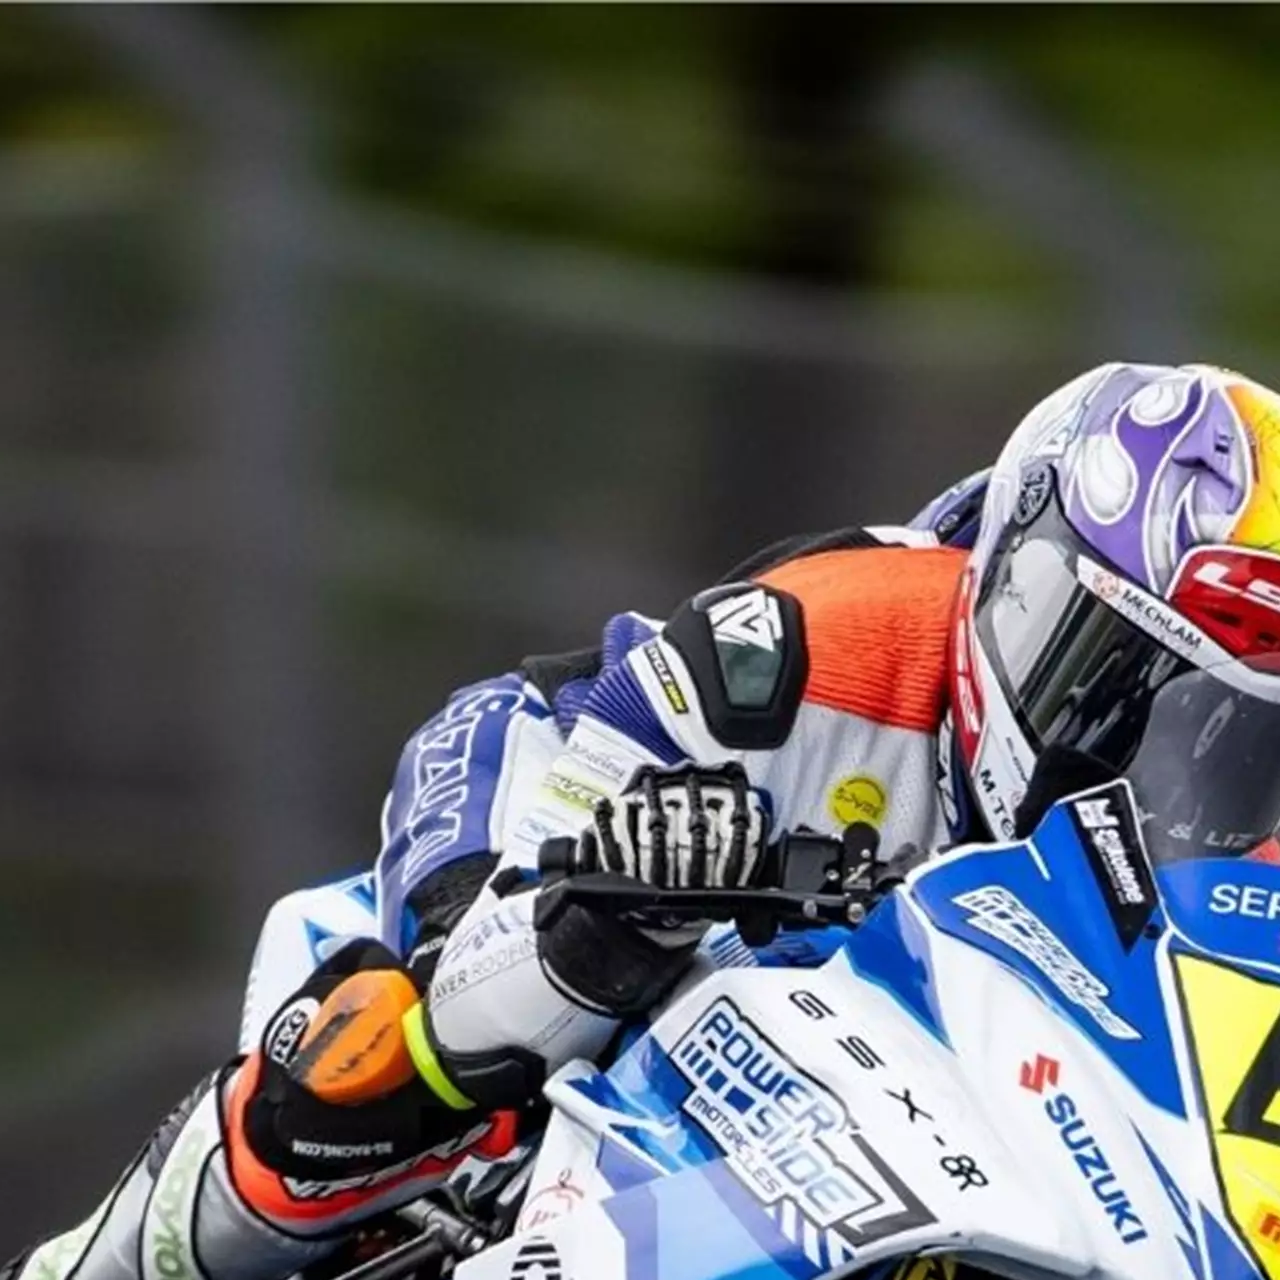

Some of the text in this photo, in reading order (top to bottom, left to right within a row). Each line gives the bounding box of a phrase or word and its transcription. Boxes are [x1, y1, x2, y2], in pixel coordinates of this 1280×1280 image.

[700, 1010, 837, 1136] POWER
[744, 1104, 858, 1216] SIDE
[1044, 1092, 1149, 1245] SUZUKI
